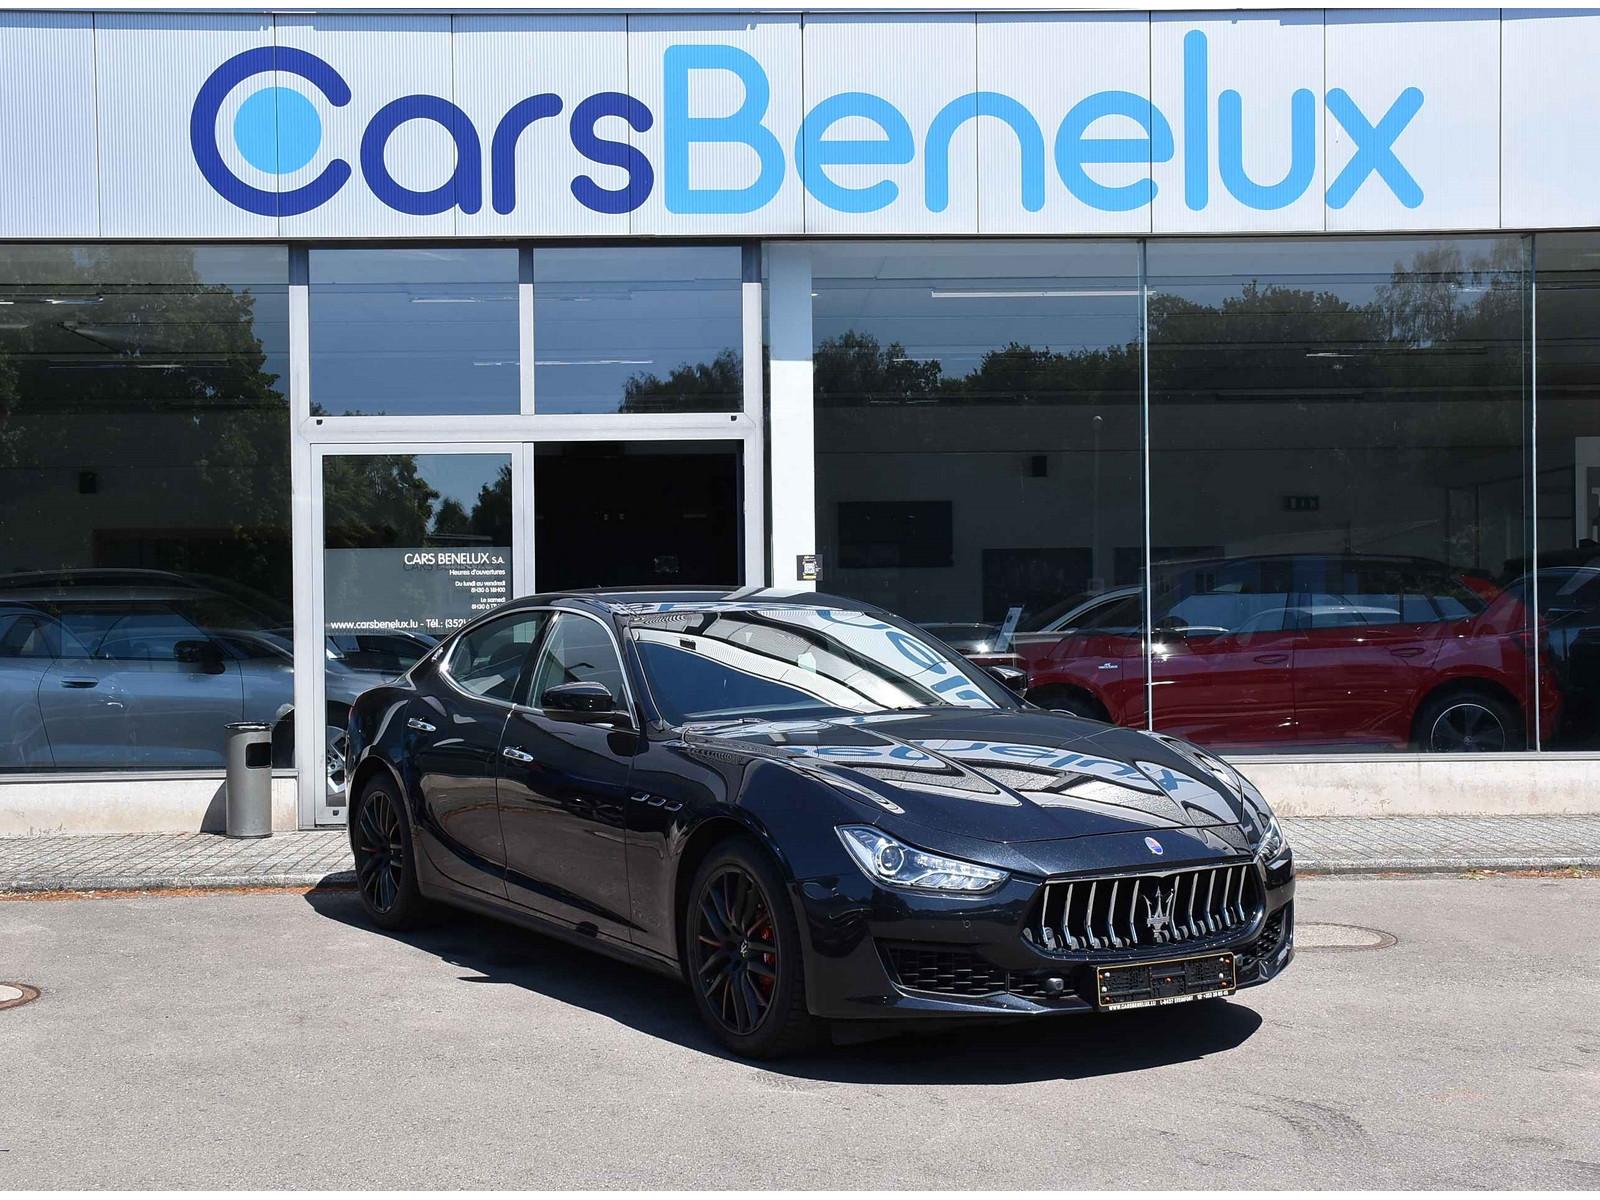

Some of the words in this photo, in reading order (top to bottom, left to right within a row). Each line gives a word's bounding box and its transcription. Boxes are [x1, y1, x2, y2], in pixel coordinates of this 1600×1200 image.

[404, 553, 435, 565] CARS
[437, 552, 490, 565] BENELUX
[330, 618, 418, 630] www.carsbenelux.lu
